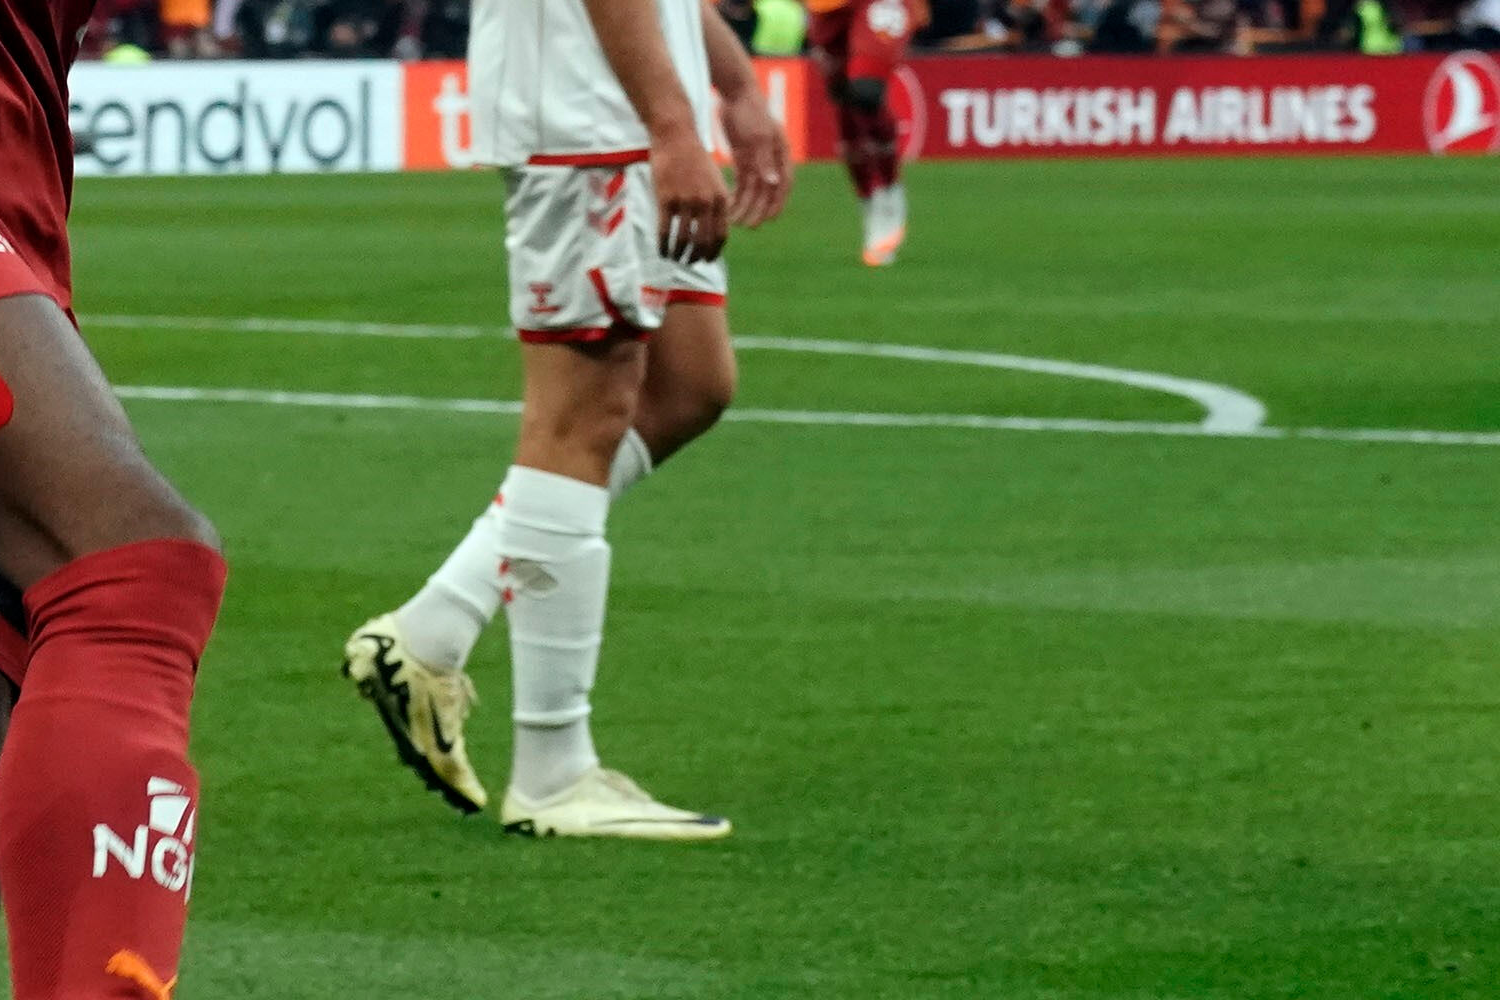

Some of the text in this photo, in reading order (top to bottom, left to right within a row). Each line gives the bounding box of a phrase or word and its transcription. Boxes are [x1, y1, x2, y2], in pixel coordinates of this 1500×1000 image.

[71, 79, 373, 172] endyol
[940, 84, 1377, 147] TURKISH AIRLINES
[92, 822, 196, 905] NG
